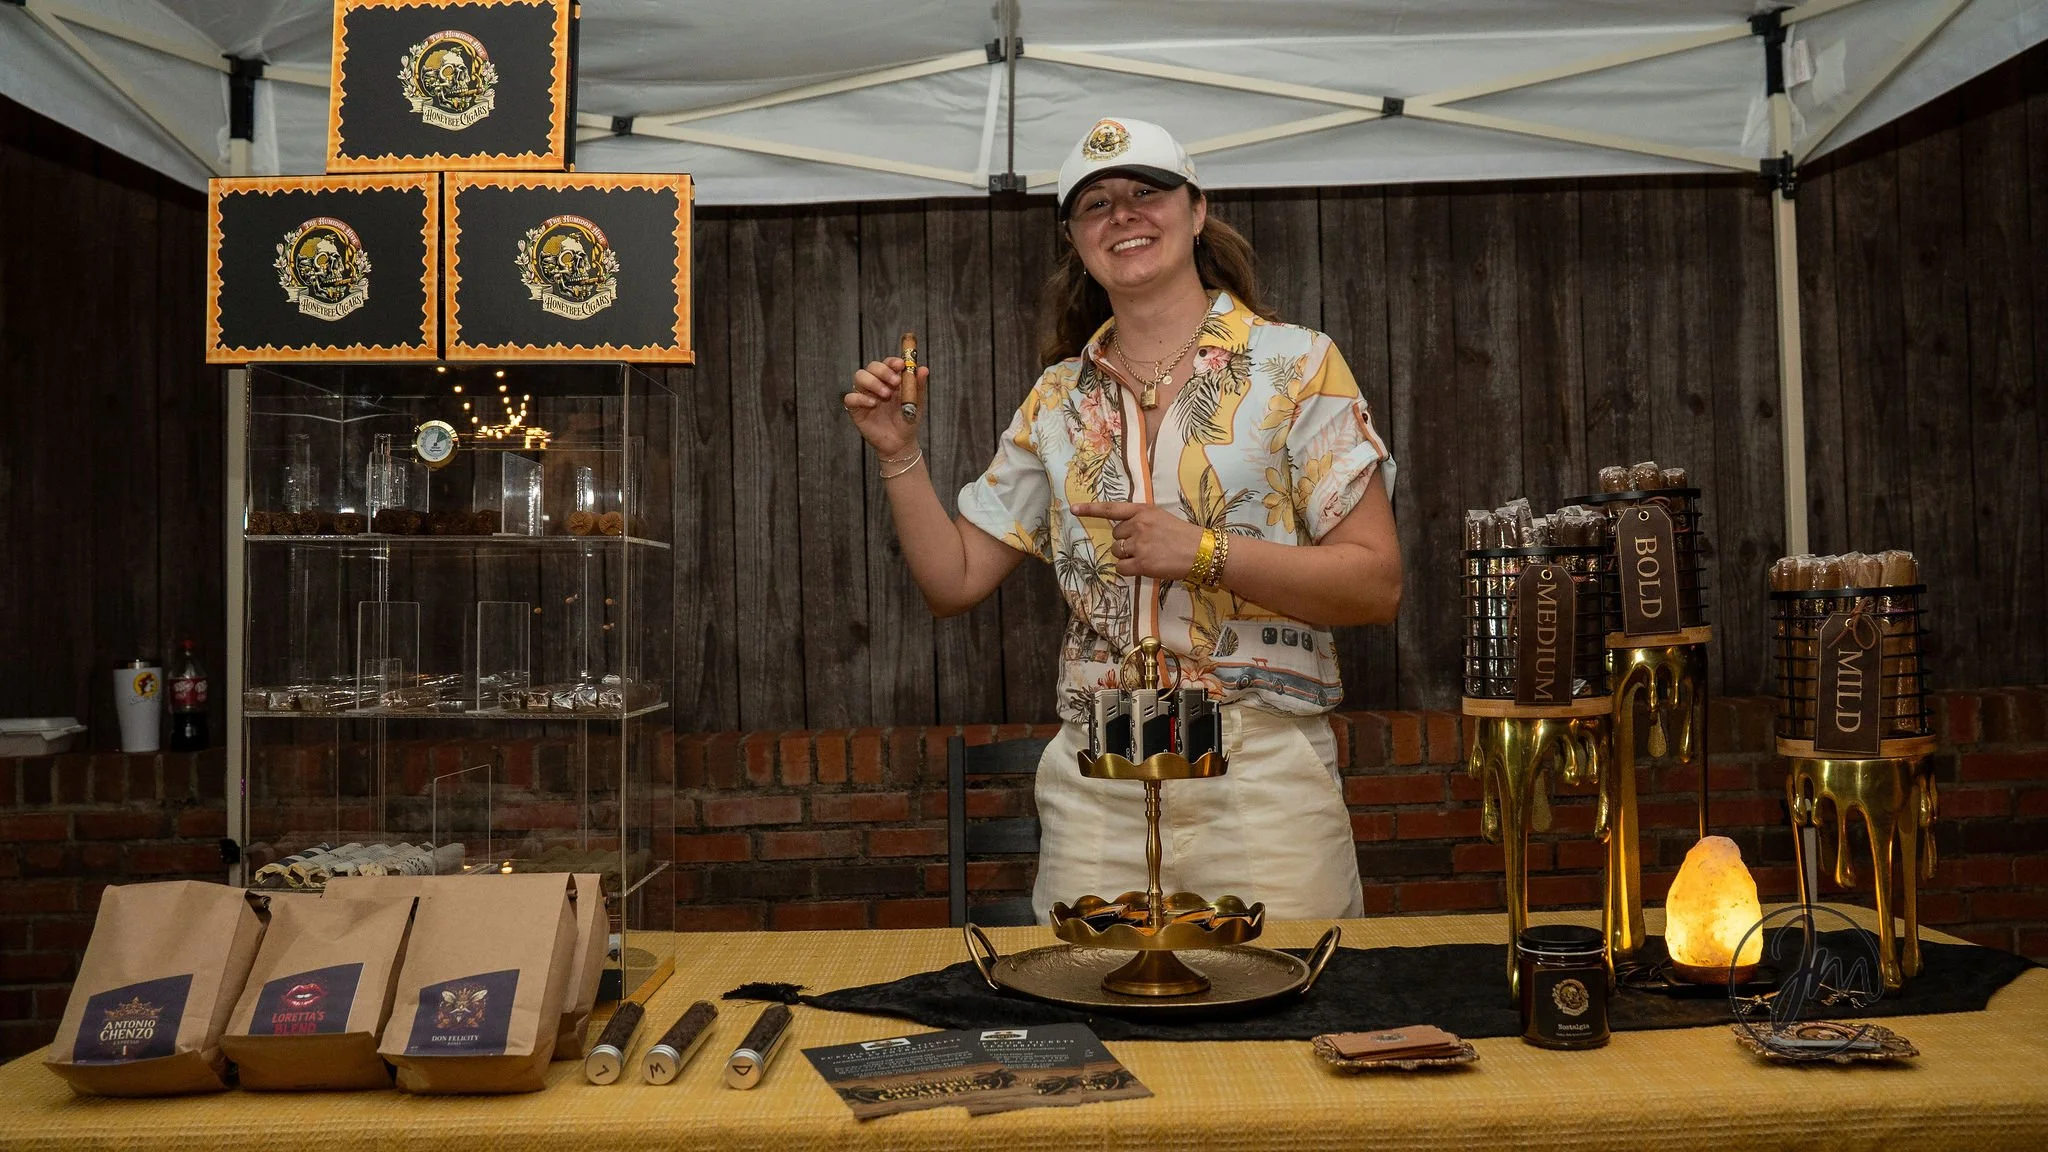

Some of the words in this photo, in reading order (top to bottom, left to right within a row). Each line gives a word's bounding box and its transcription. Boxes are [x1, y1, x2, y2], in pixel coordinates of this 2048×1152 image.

[424, 108, 460, 127] HONEYBEE
[460, 106, 488, 126] CIGARS
[300, 298, 336, 317] HONEYBEE
[335, 295, 362, 316] CIGARS
[544, 296, 582, 317] HONEYBEE
[581, 294, 610, 316] CIGARS
[1635, 536, 1663, 619] BOLD
[1534, 581, 1558, 701] MEDIUM
[1835, 648, 1863, 733] MILD
[103, 1018, 156, 1031] ANTONIO
[271, 1010, 326, 1025] LORETTA'S
[99, 1027, 154, 1042] CHENZO
[1557, 1023, 1590, 1032] Nostalgia
[431, 1034, 447, 1042] DON
[448, 1033, 481, 1042] FELICITY
[649, 1062, 666, 1079] M
